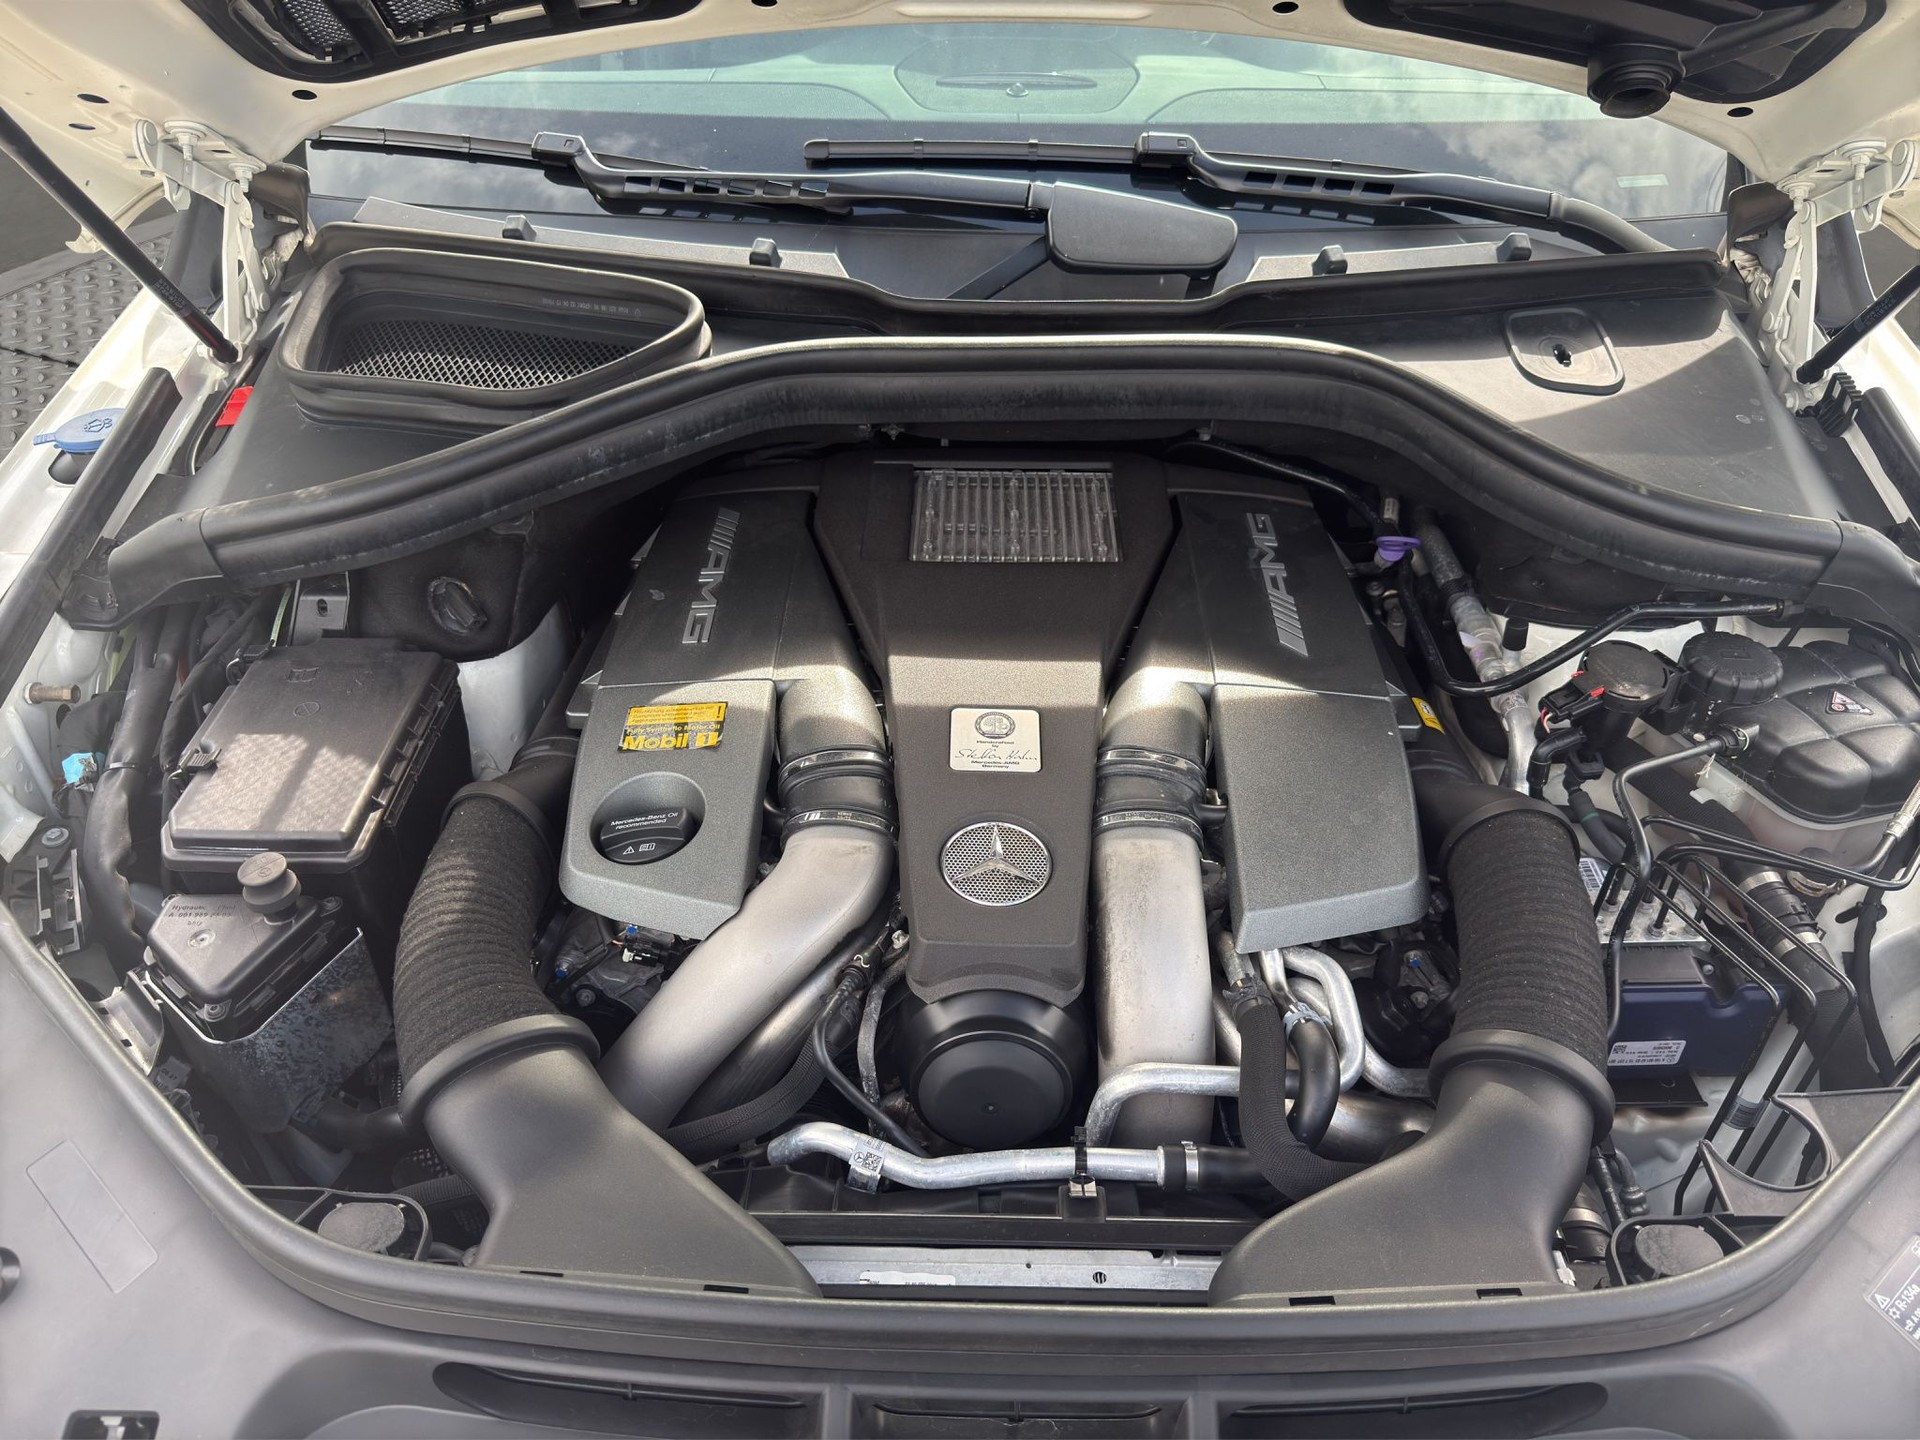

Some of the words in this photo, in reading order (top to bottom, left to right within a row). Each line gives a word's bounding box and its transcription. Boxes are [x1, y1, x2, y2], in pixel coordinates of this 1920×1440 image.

[622, 734, 689, 750] Mobil
[696, 731, 718, 747] 1
[611, 814, 667, 826] Mercedes-Benz
[615, 819, 667, 830] recommended
